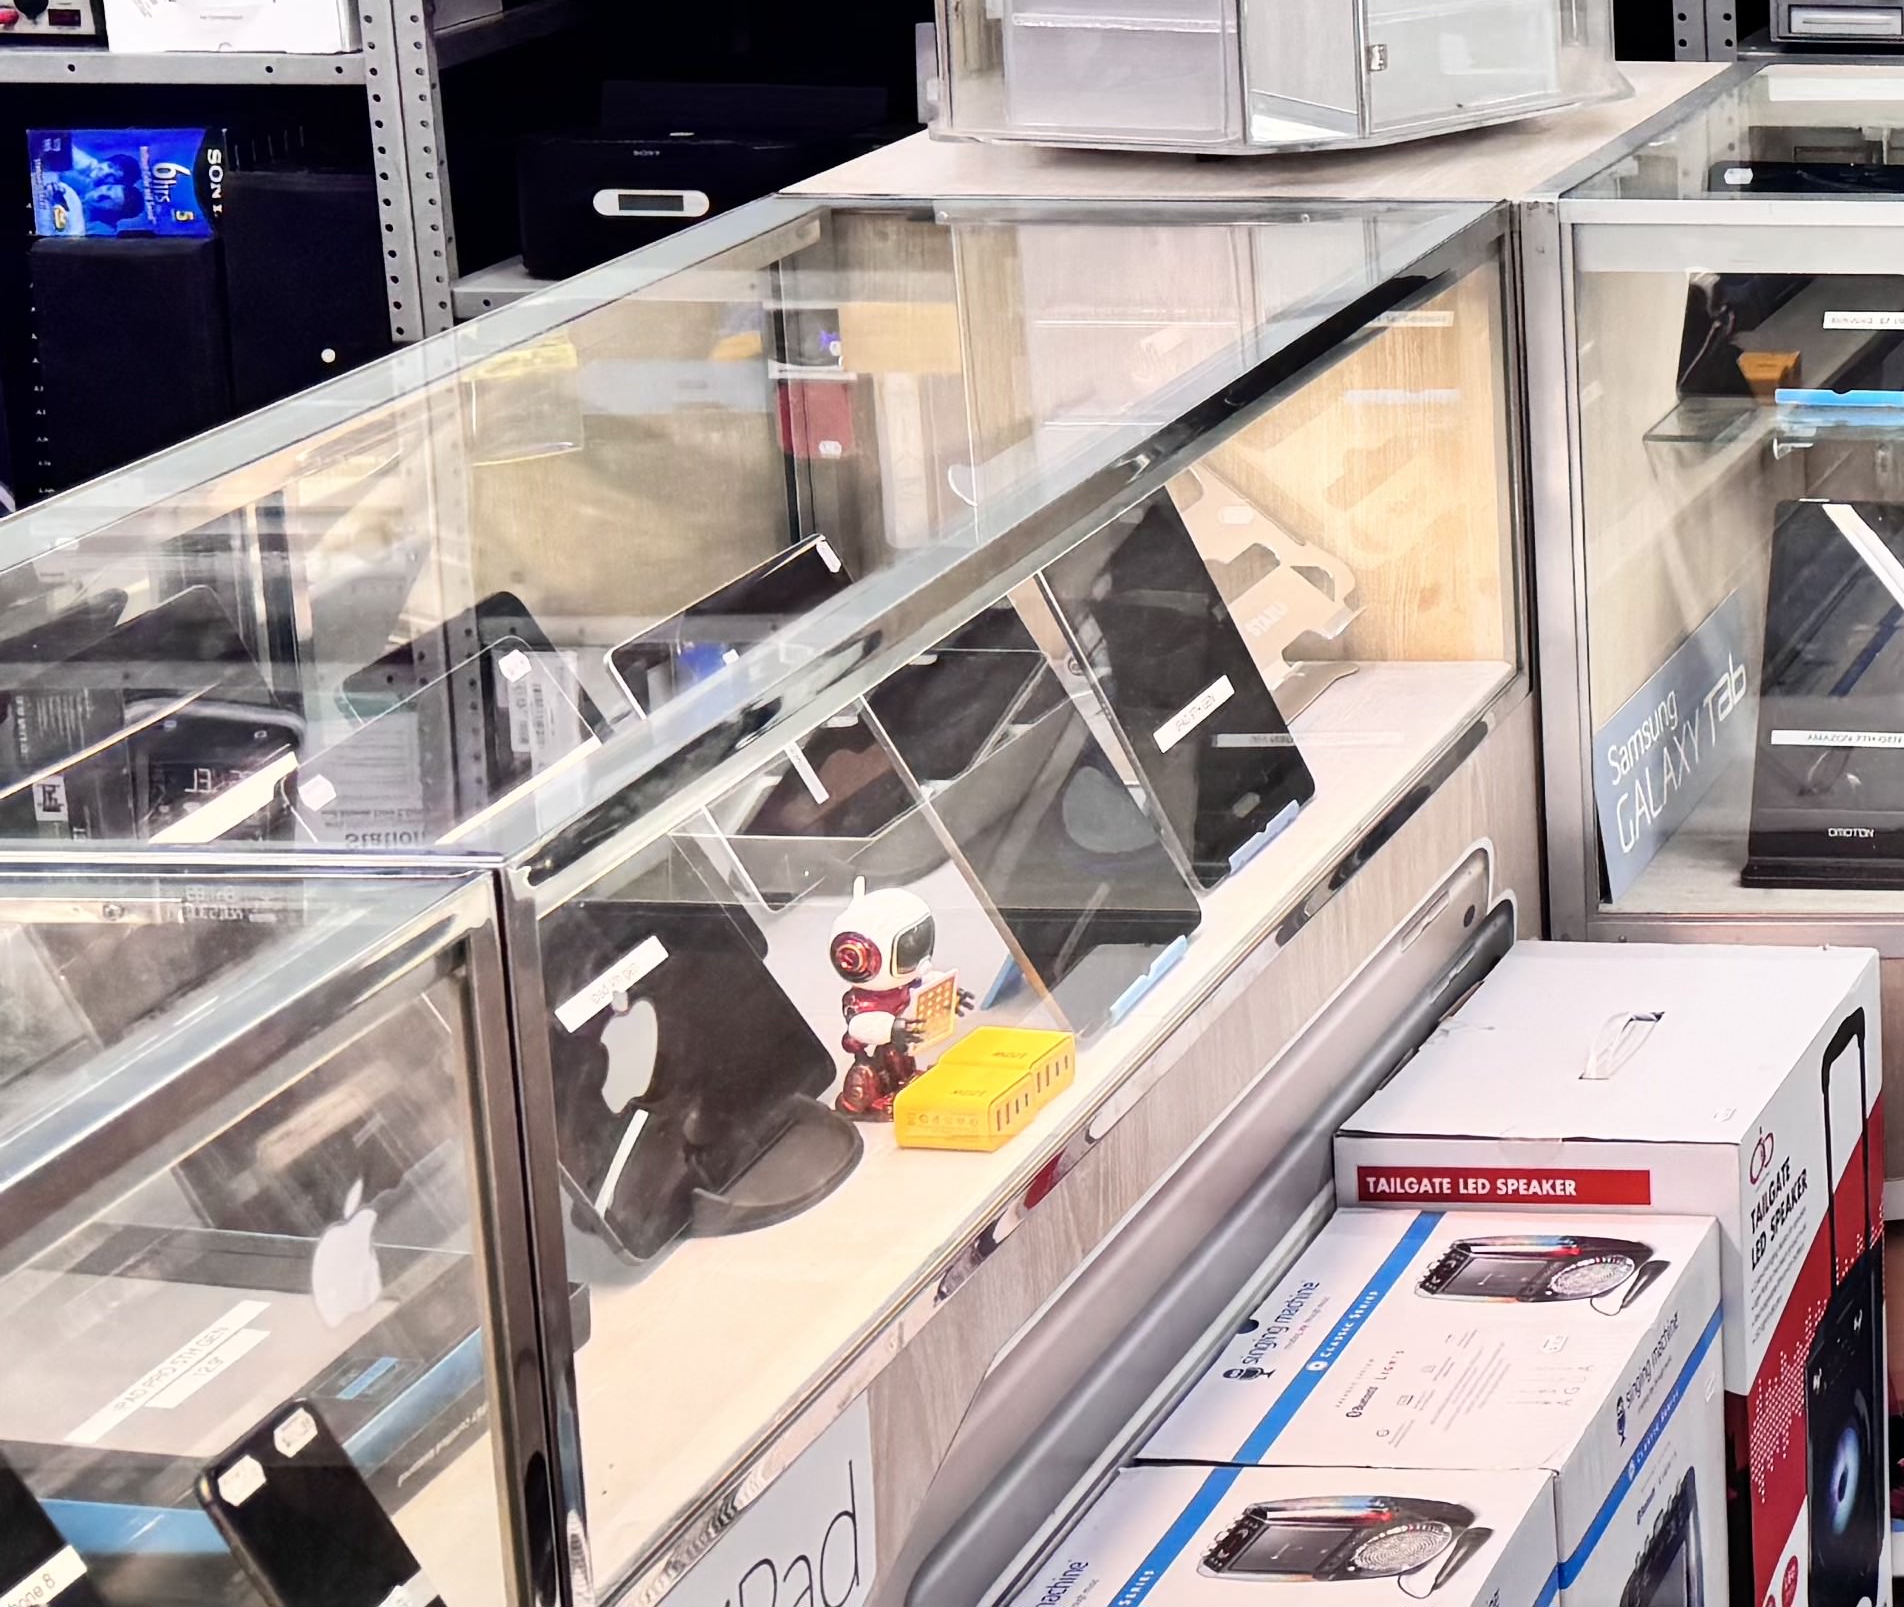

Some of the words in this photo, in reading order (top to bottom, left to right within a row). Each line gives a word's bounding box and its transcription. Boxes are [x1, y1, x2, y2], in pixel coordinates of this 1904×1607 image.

[1607, 687, 1679, 785] Samsung
[1615, 705, 1702, 854] GALAXY
[1702, 651, 1747, 746] Tab
[1827, 827, 1875, 839] OMOTON
[1365, 1176, 1452, 1196] TAILGATE
[1457, 1176, 1491, 1196] LED
[1495, 1176, 1577, 1197] SPEAKER
[1749, 1154, 1792, 1235] TAILGATE
[1750, 1233, 1769, 1271] LED
[1769, 1167, 1809, 1240] SPEAKER
[1240, 1315, 1282, 1366] singing
[1278, 1279, 1321, 1320] machine
[1319, 1316, 1356, 1359] CLASSIC
[1349, 1289, 1378, 1325] SERIES
[1624, 1360, 1652, 1410] singing
[1648, 1309, 1681, 1365] machine
